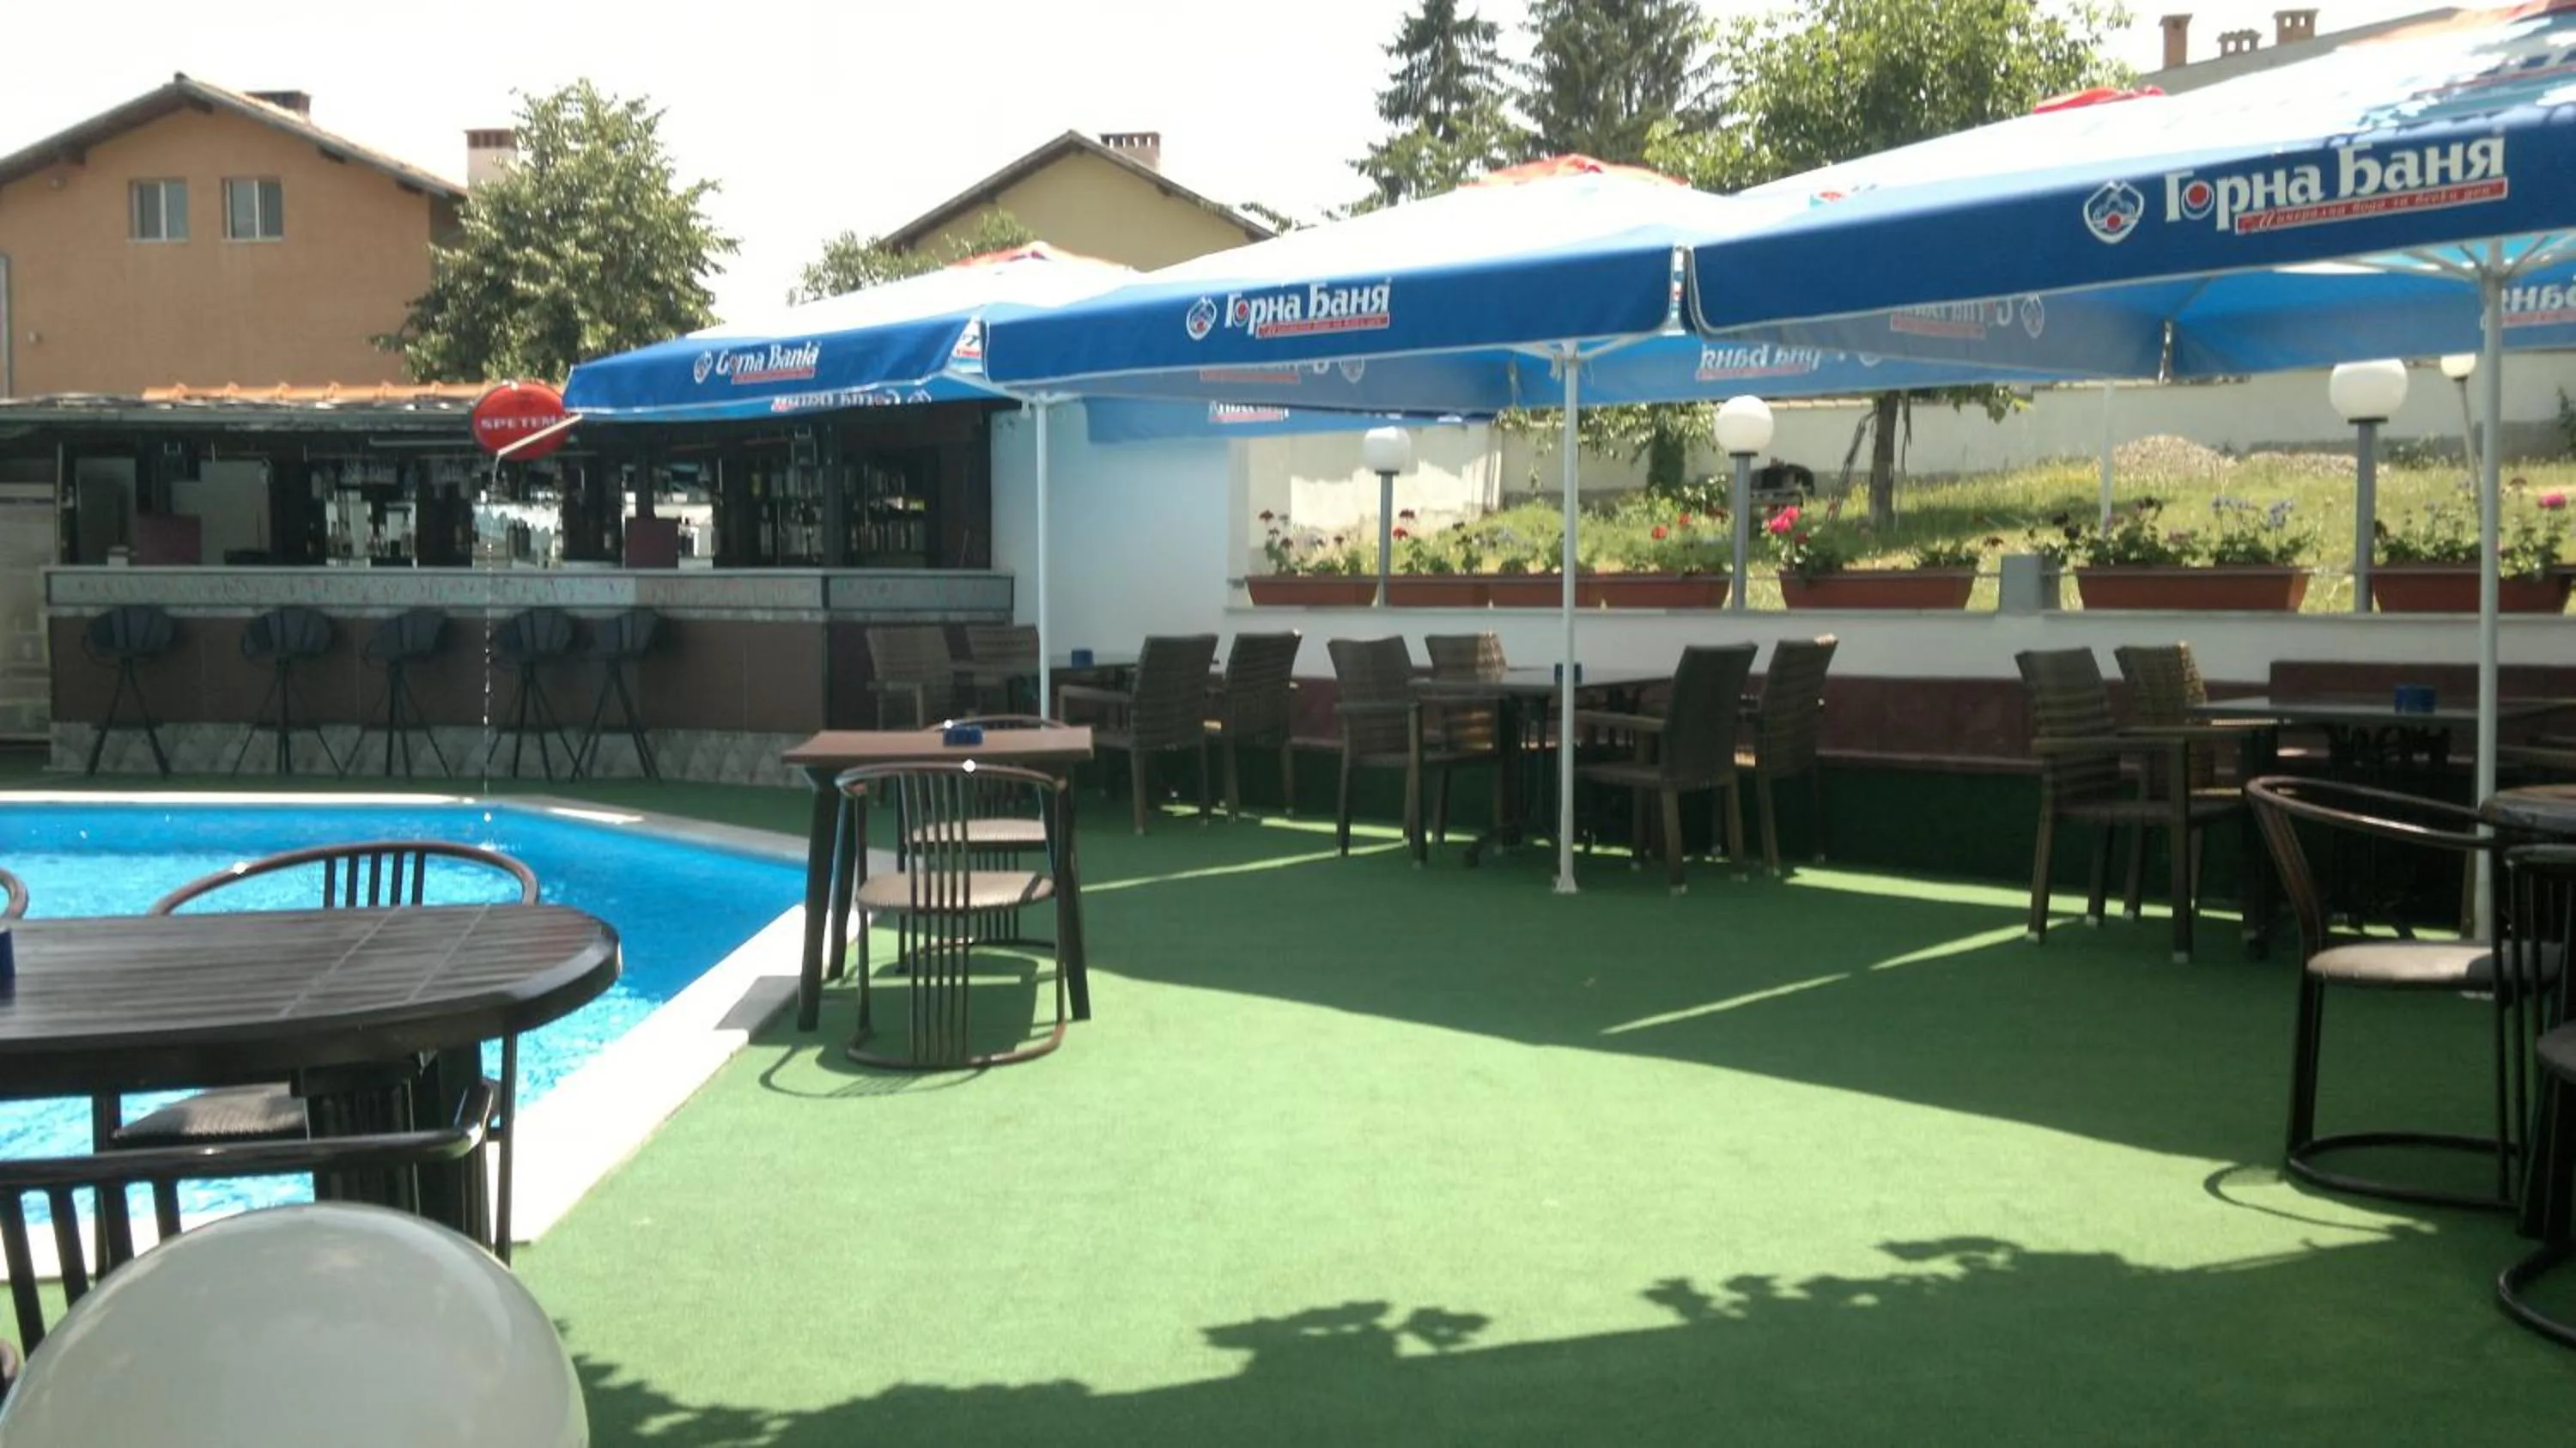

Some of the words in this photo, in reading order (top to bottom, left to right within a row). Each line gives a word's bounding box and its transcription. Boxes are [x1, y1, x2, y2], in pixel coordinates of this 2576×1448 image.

[2165, 166, 2325, 231] Горна
[2337, 137, 2506, 198] Баня
[1224, 289, 1301, 336] Горна
[1309, 282, 1390, 319] Баня
[715, 348, 765, 375] Gorna
